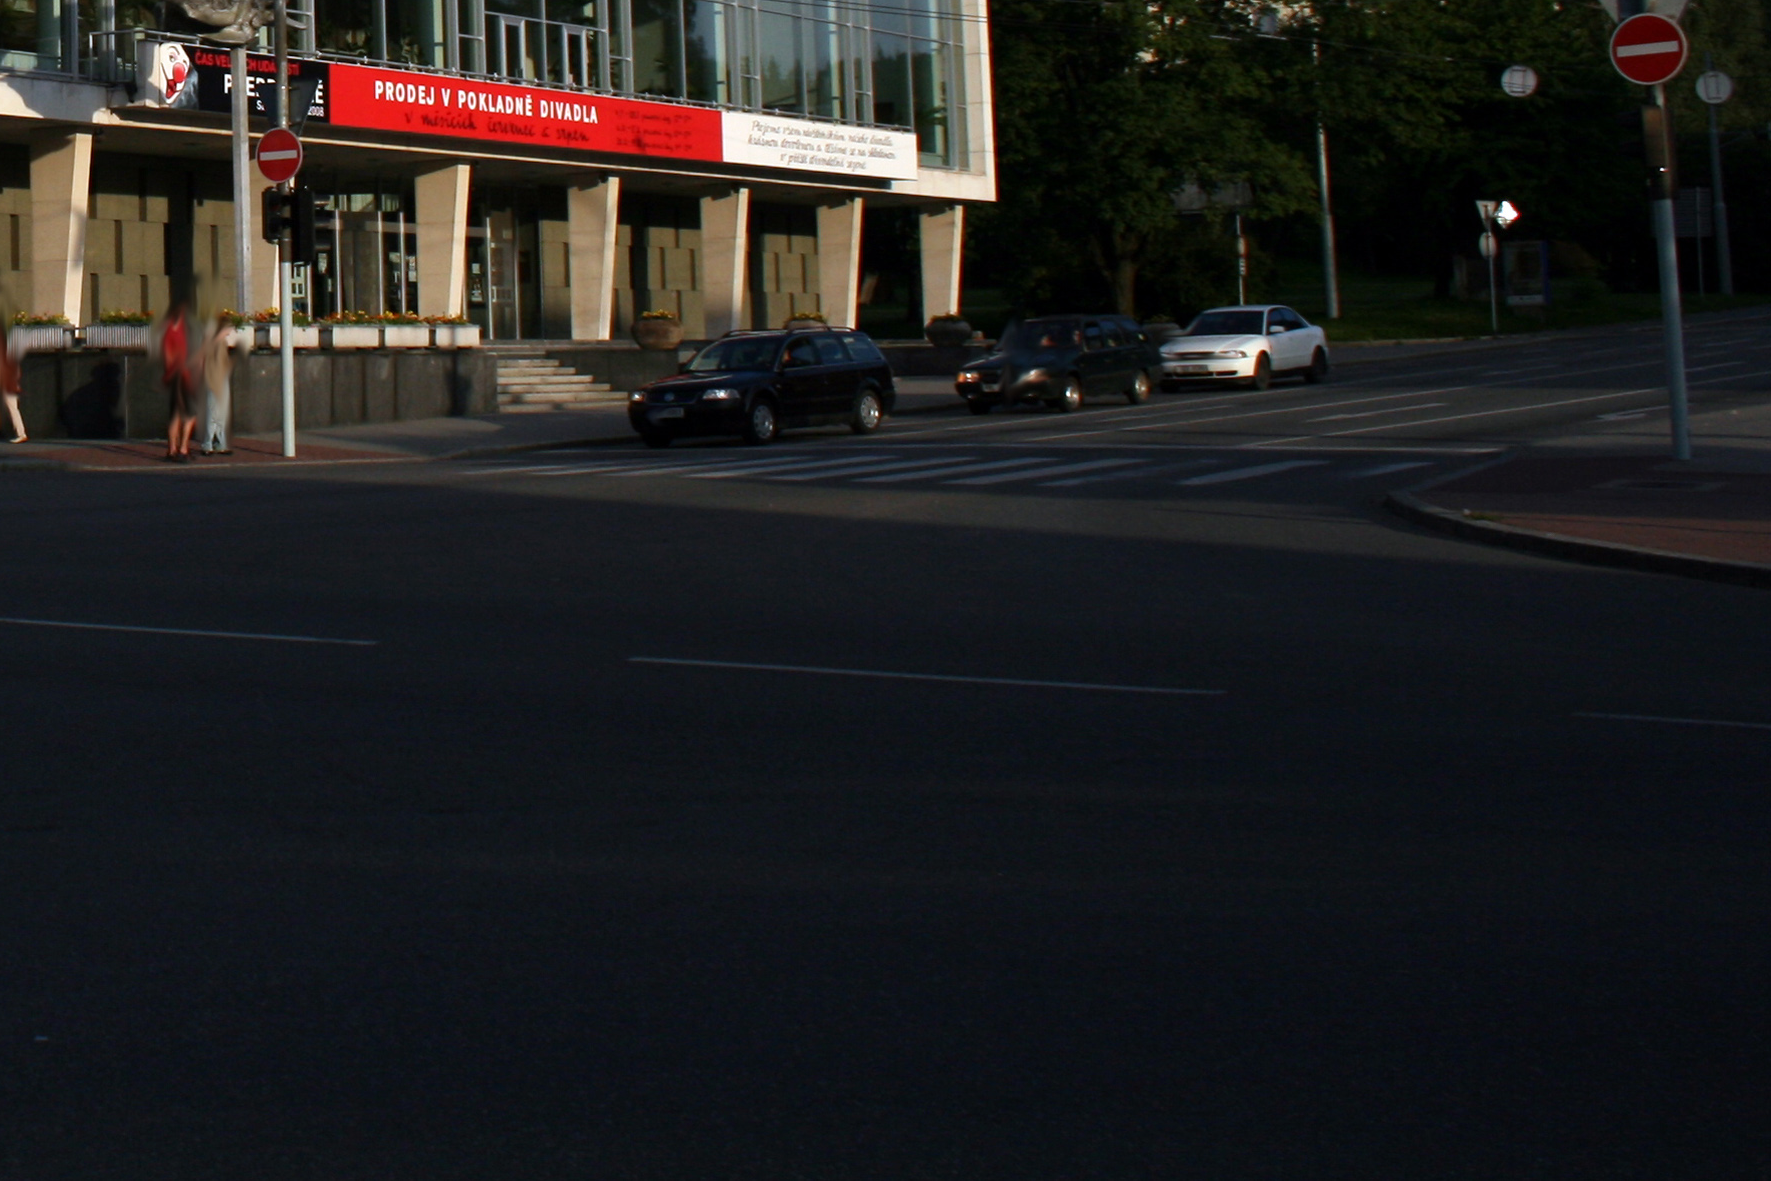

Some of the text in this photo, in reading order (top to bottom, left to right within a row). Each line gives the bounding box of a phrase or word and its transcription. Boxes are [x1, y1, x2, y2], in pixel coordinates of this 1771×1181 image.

[194, 50, 214, 66] ČAS
[215, 54, 256, 71] VELCH
[374, 80, 435, 105] PRODEJ
[441, 88, 451, 107] V
[458, 90, 533, 116] POKLADNĚ
[540, 100, 599, 124] DIVADLA
